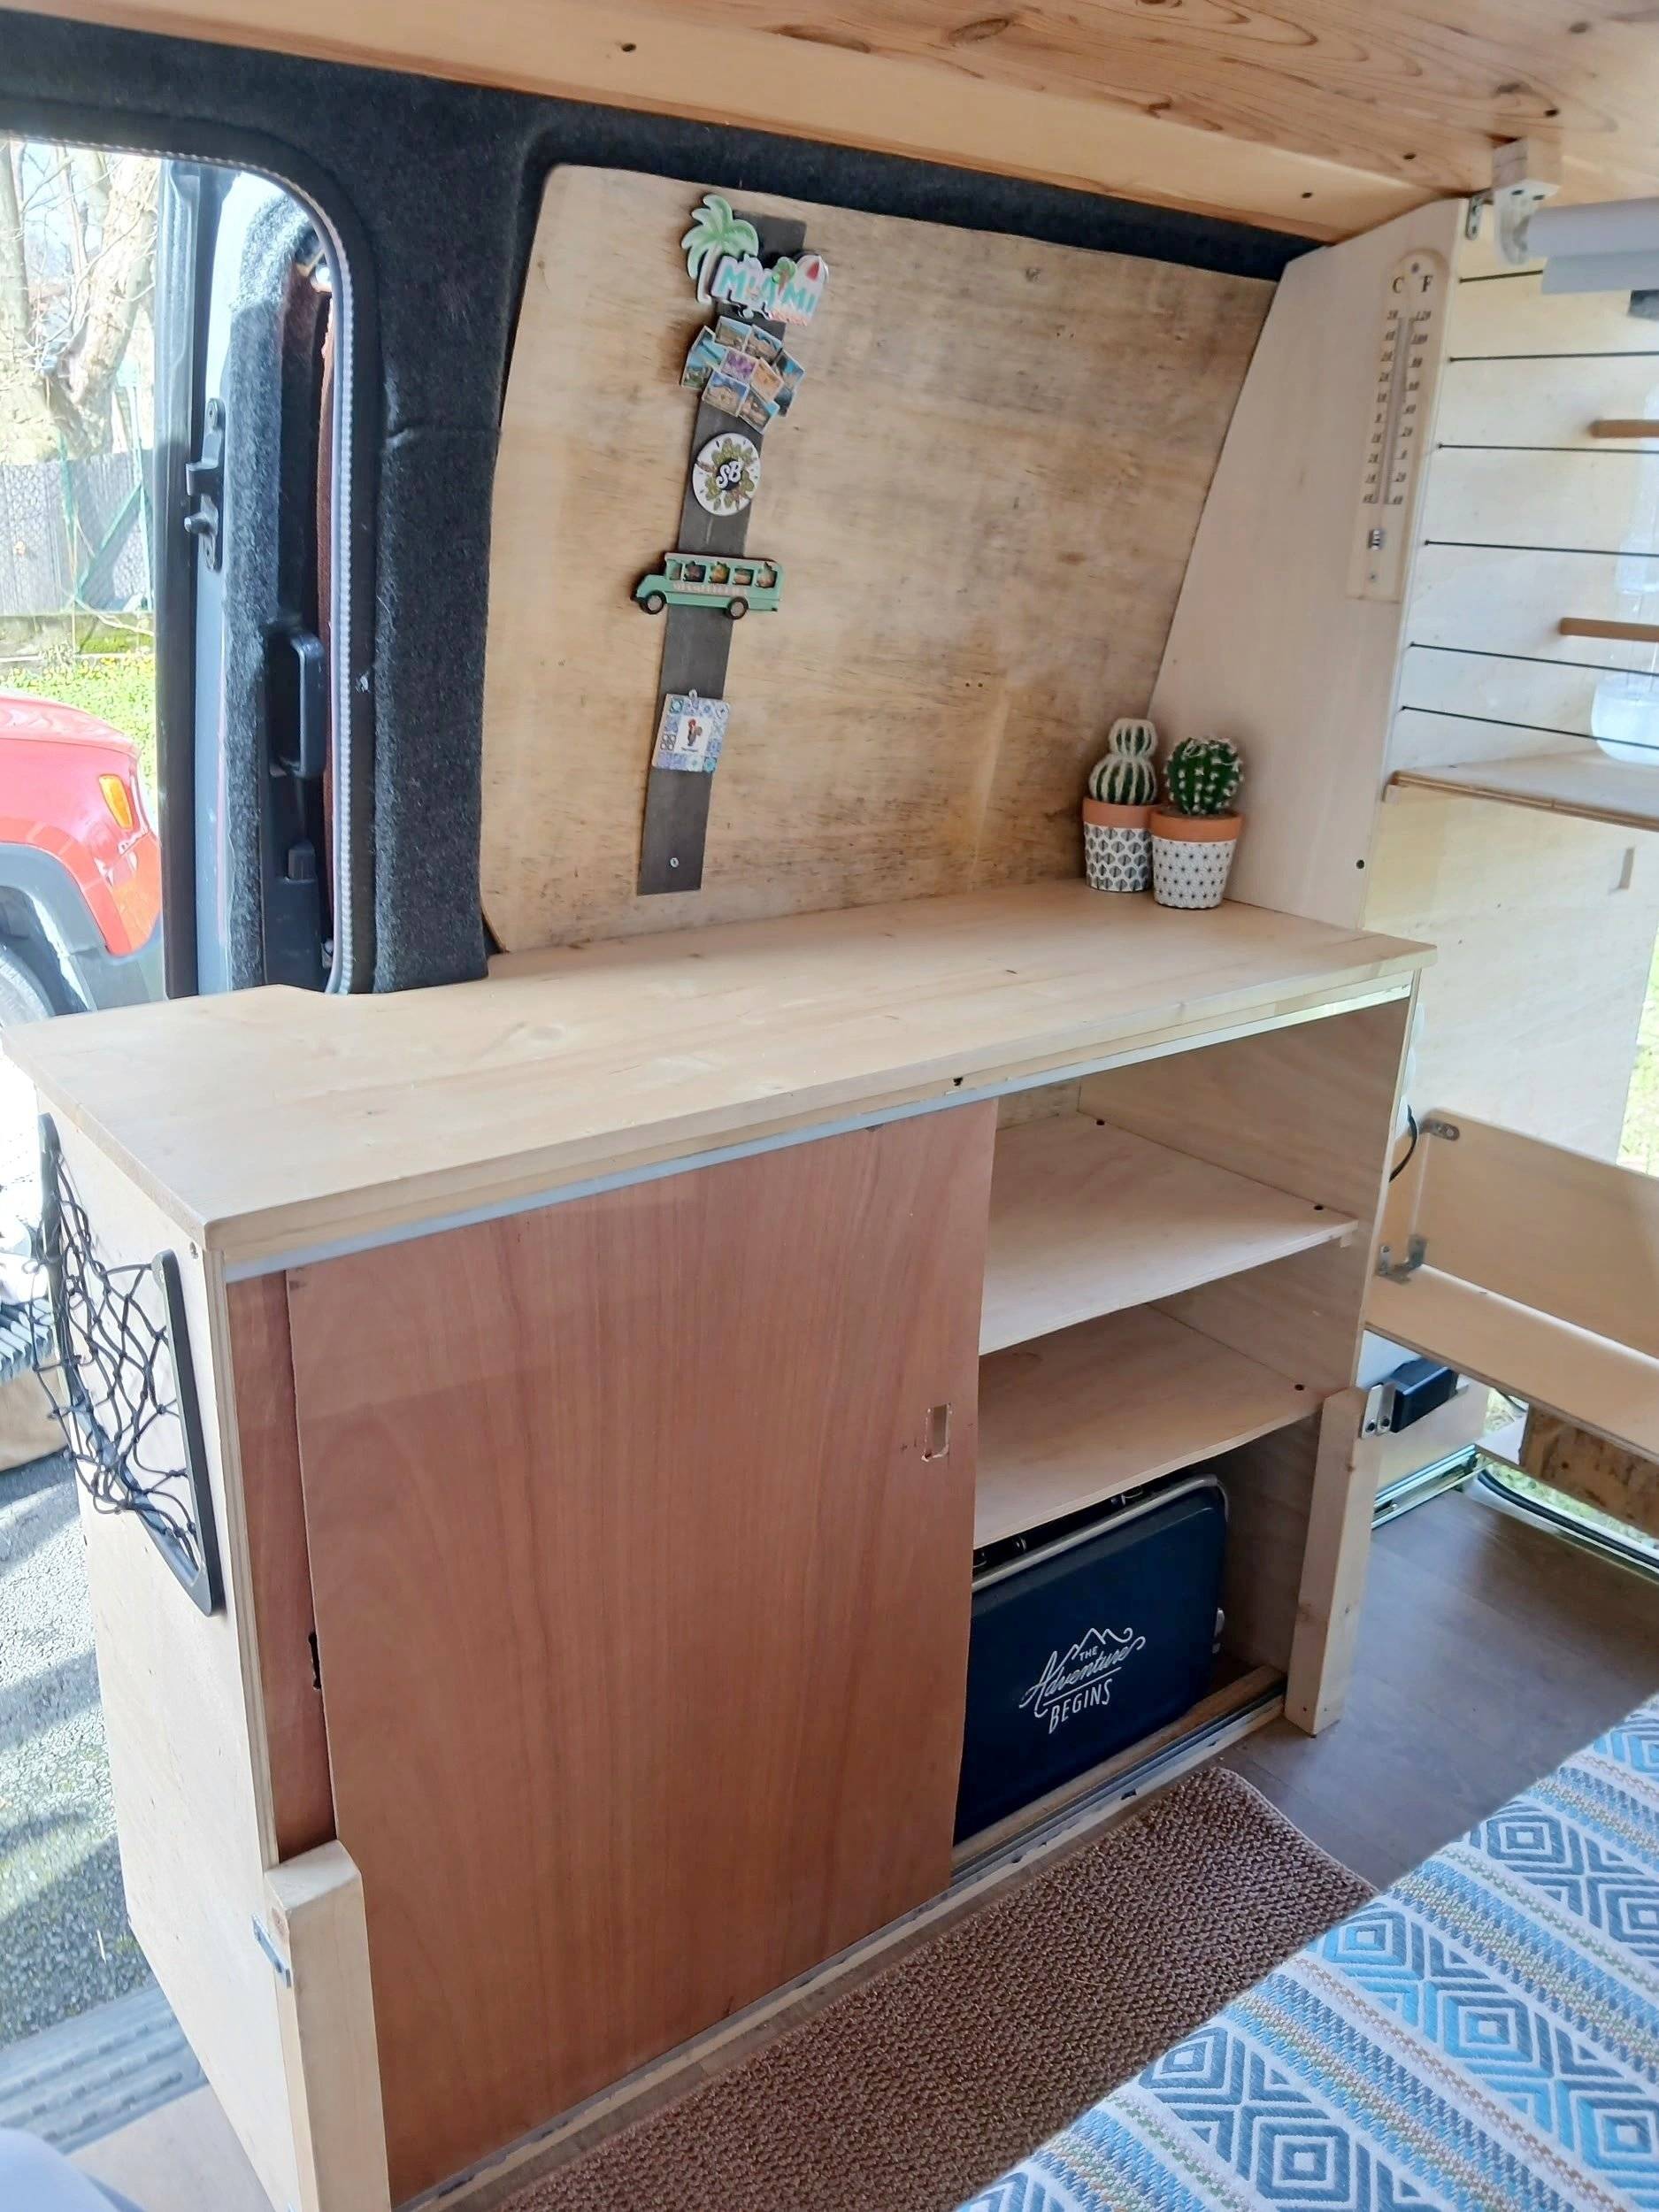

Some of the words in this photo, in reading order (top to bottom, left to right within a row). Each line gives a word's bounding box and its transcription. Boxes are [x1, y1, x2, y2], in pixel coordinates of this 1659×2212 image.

[1392, 276, 1405, 293] C
[1421, 275, 1433, 293] F
[1079, 1646, 1099, 1661] THE
[1019, 1635, 1146, 1717] Adventure
[1048, 1678, 1113, 1734] BEGINS
